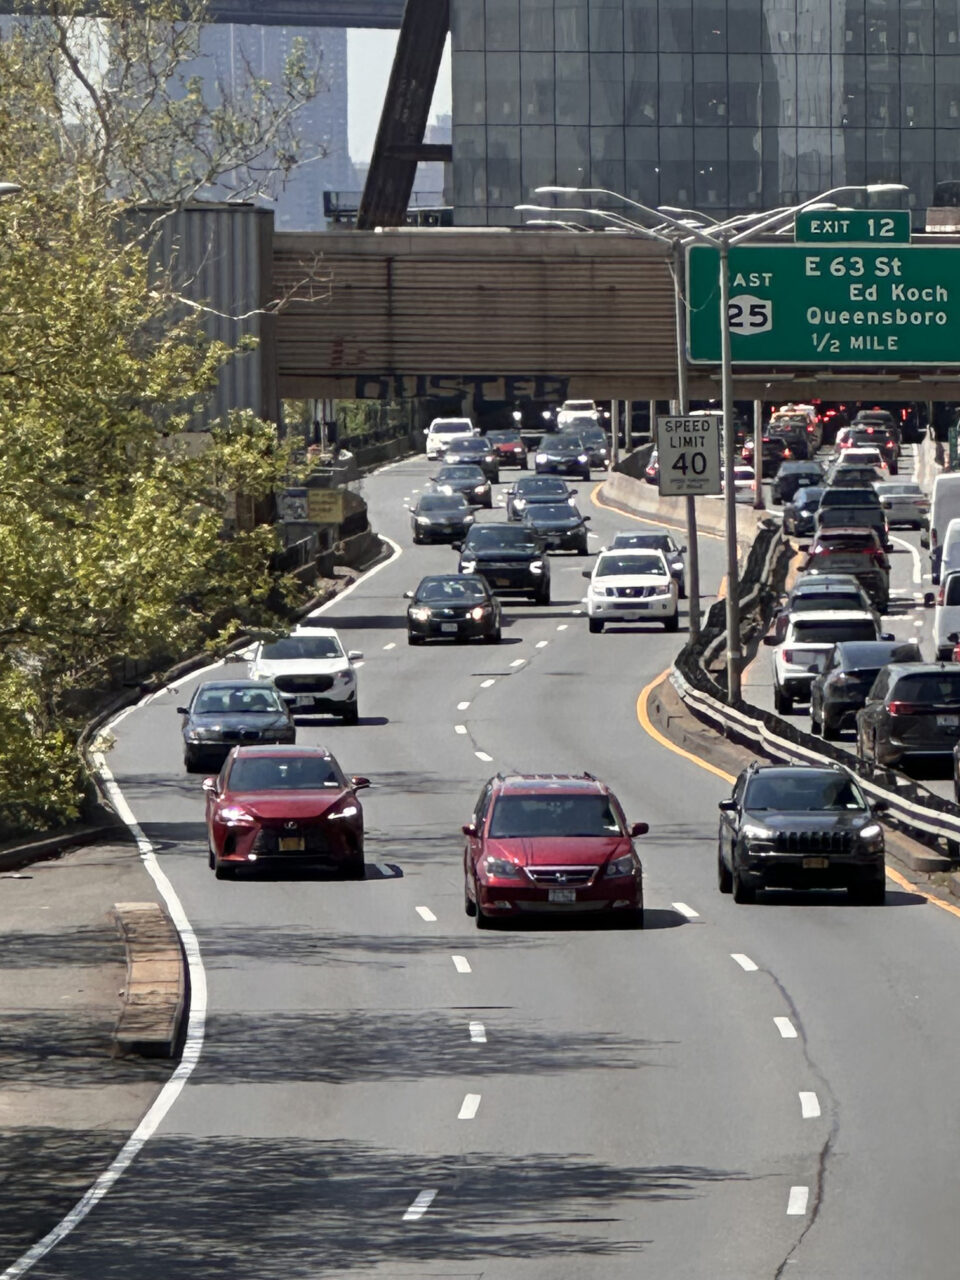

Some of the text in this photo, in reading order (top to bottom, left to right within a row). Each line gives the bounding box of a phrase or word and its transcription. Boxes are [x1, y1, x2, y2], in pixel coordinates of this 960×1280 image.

[810, 218, 895, 237] EXIT 12
[805, 256, 902, 277] E 63 St
[730, 273, 773, 287] AST
[850, 284, 948, 302] Ed Koch
[728, 304, 768, 327] 25
[807, 307, 947, 325] Queensboro
[850, 336, 898, 350] MILE
[665, 420, 710, 432] SPEED
[670, 436, 705, 448] LIMIT
[672, 452, 707, 476] 40
